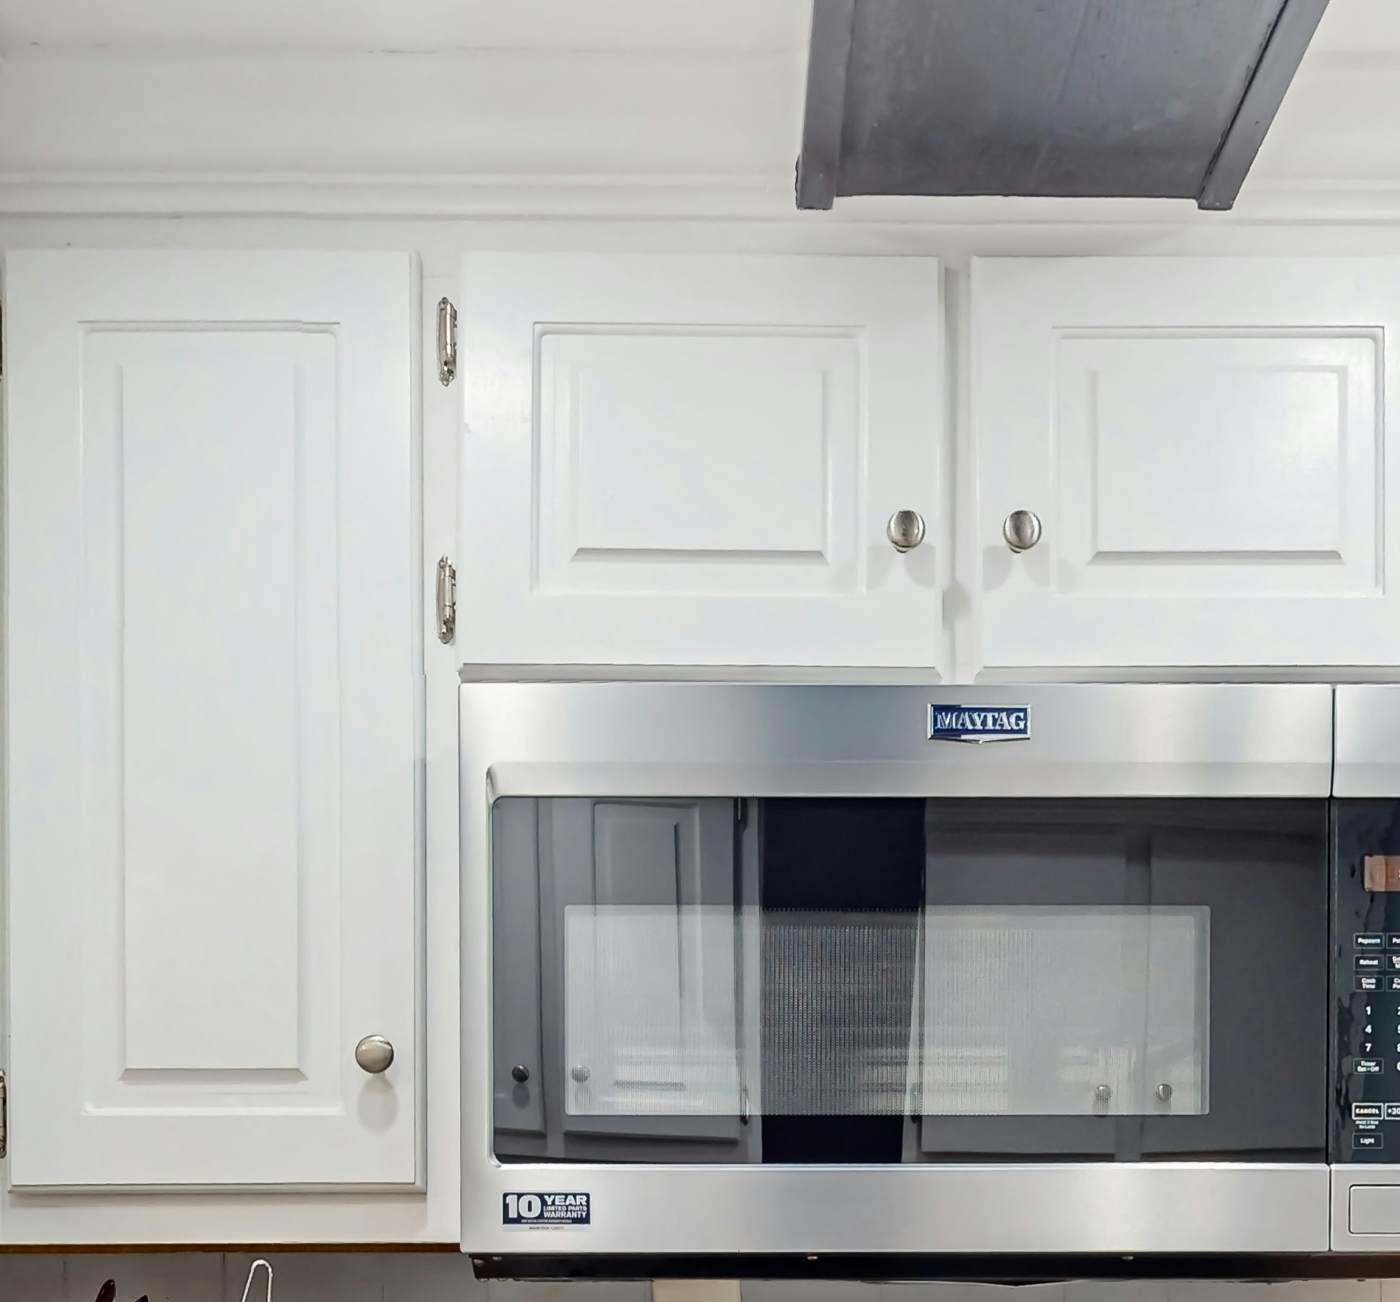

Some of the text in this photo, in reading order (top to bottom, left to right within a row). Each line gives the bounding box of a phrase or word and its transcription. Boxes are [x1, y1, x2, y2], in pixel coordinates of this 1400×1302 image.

[934, 711, 1026, 730] MAYTAG
[1366, 1006, 1371, 1015] 1
[1365, 1024, 1372, 1034] 4
[1365, 1043, 1372, 1052] 7
[544, 1195, 587, 1205] YEAR
[505, 1194, 541, 1218] 10
